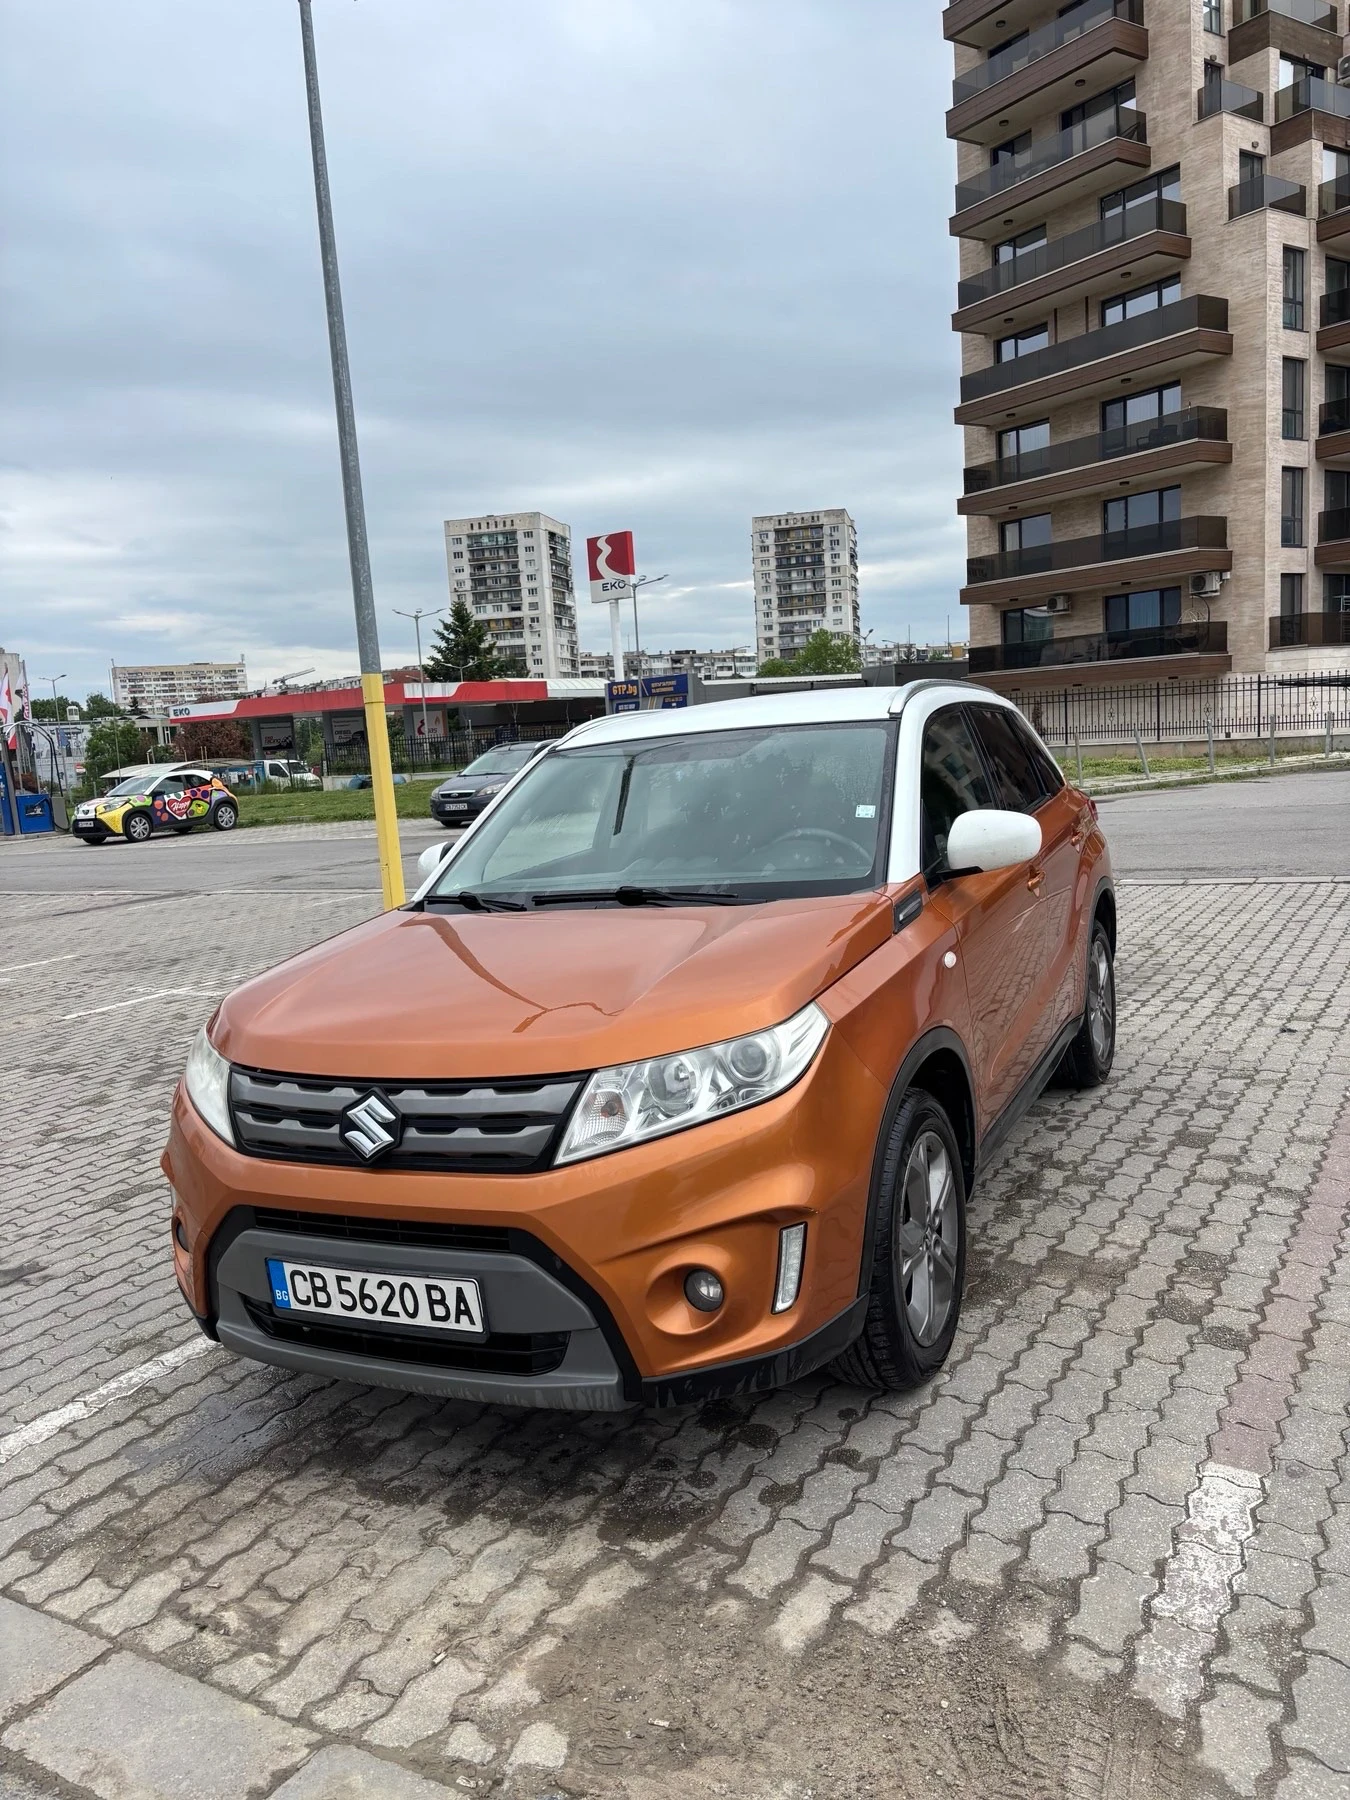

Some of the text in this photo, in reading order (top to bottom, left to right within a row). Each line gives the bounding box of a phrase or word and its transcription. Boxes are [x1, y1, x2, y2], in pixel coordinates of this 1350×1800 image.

[601, 580, 626, 591] EKO
[173, 707, 190, 717] EKO
[275, 1289, 289, 1301] BG
[289, 1269, 476, 1326] CB 5620 BA
